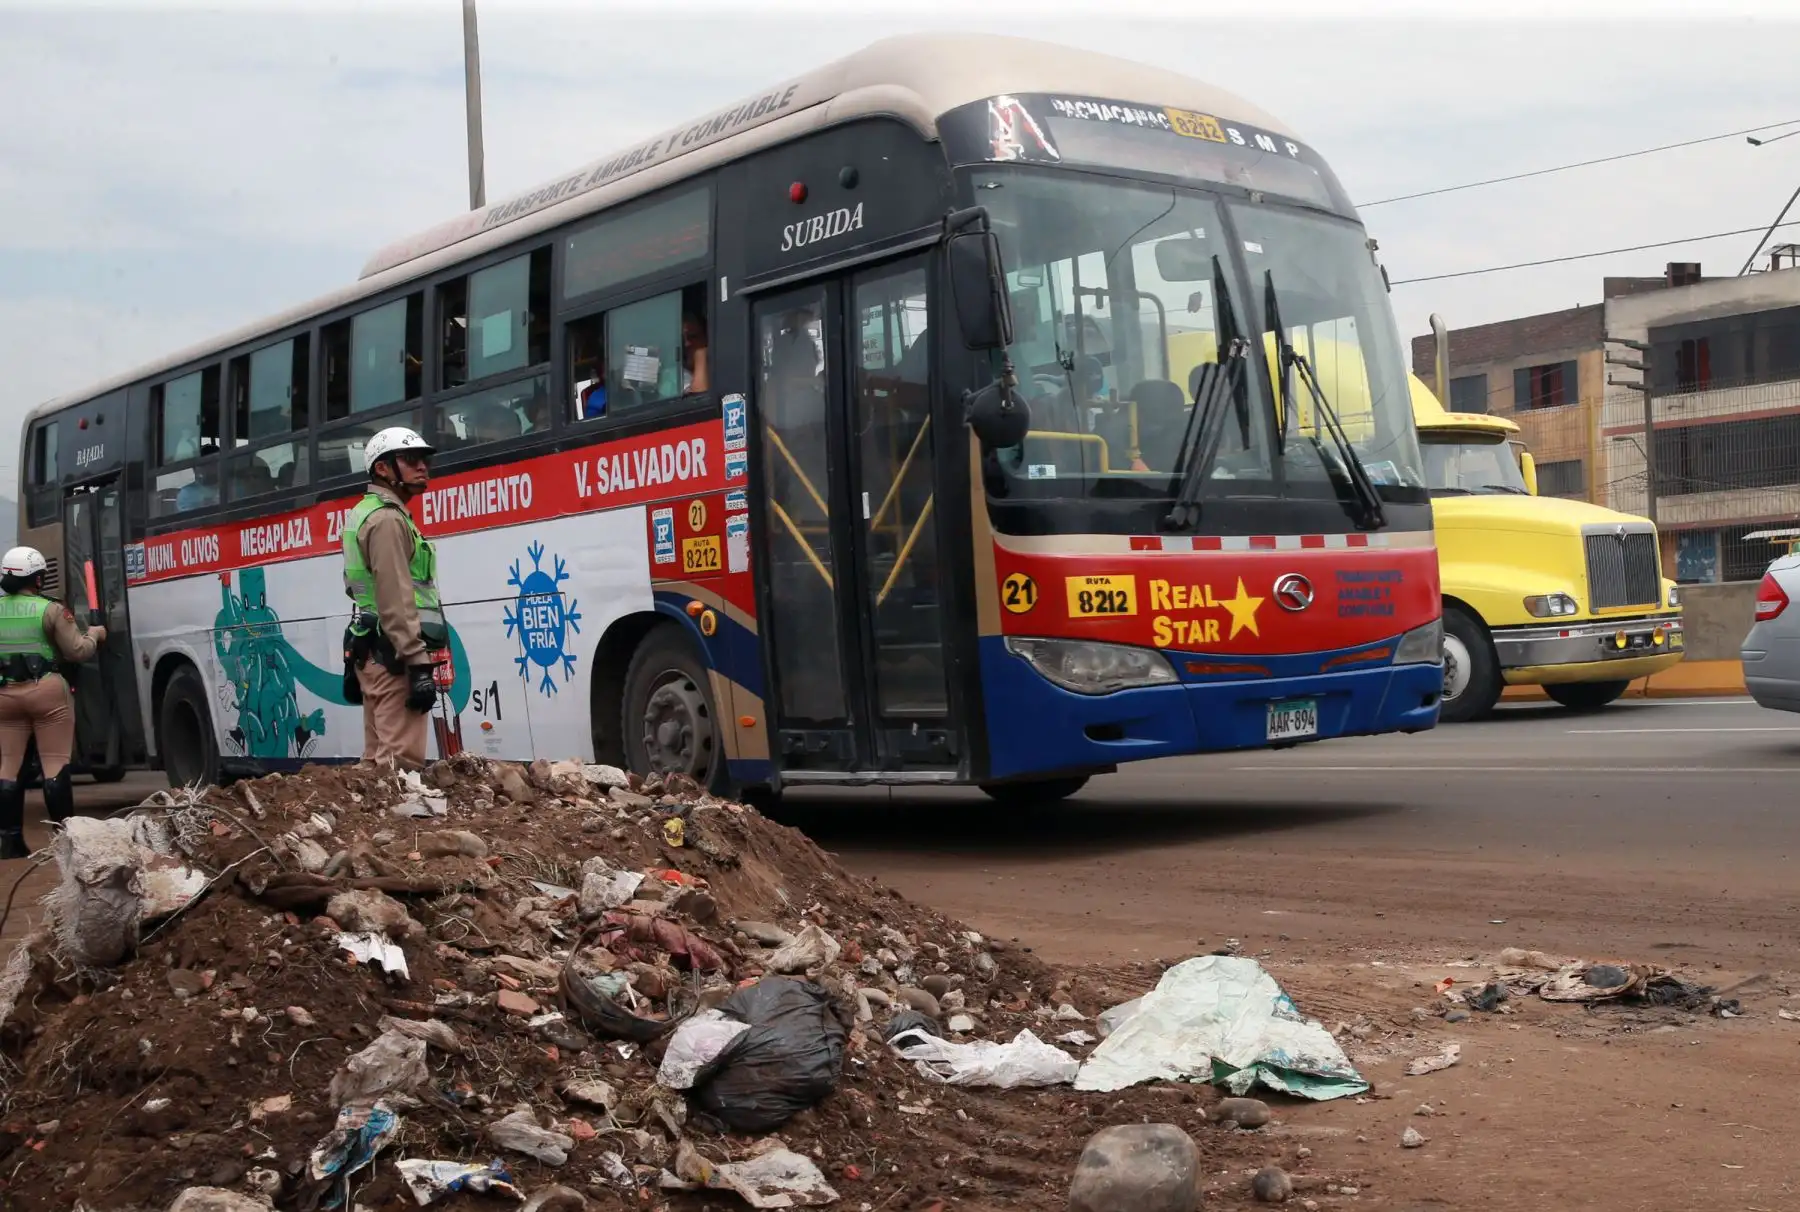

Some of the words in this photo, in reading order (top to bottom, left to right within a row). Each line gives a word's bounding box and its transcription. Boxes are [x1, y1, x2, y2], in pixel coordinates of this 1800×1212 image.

[483, 172, 587, 228] TRANSPORTE
[585, 140, 662, 187] AMABLE
[667, 131, 683, 151] Y
[682, 84, 798, 146] CONFIABLE
[781, 202, 863, 252] SUBIDA
[76, 444, 104, 468] BAJADA
[148, 543, 177, 572] MUNI.
[181, 534, 220, 566] OLIVOS
[240, 517, 313, 556] MEGAPLAZA
[422, 473, 532, 525] EVITAMIENTO
[574, 461, 592, 498] V.
[598, 438, 707, 494] SALVADOR
[692, 505, 703, 526] 21
[693, 539, 710, 548] RUTA
[686, 548, 717, 568] 8212
[1006, 579, 1033, 605] 21
[1085, 577, 1111, 585] RUTA
[1079, 590, 1129, 613] 8212
[1149, 579, 1220, 610] REAL
[522, 605, 560, 629] BIEN
[529, 629, 558, 649] FRÍA
[1152, 616, 1220, 648] STAR
